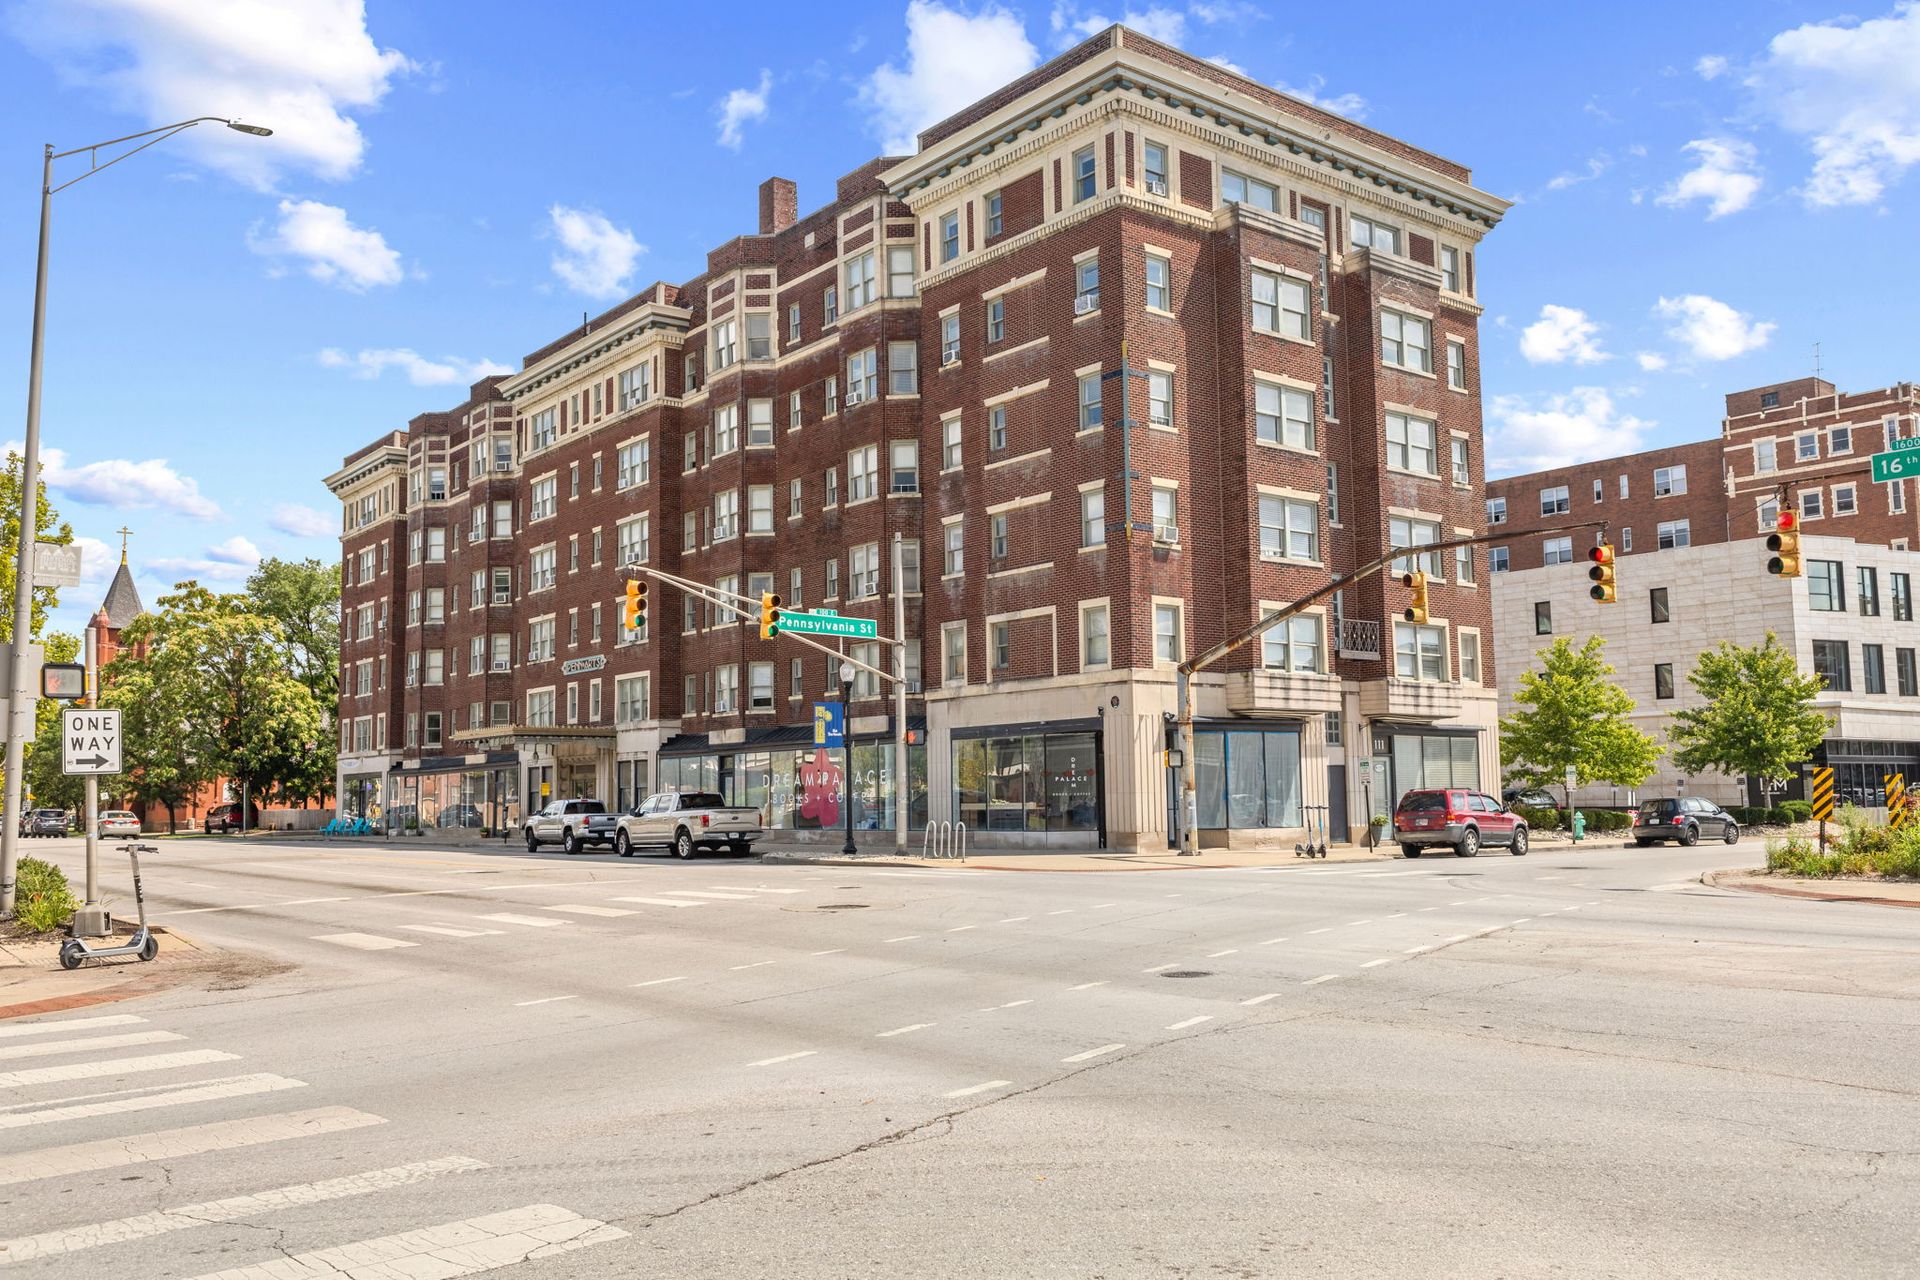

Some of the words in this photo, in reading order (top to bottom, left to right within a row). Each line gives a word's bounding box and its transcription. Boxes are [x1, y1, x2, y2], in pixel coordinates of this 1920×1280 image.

[1896, 438, 1920, 449] 1600
[779, 616, 855, 632] Pennsylvania
[860, 622, 873, 634] St
[72, 716, 113, 731] ONE
[71, 736, 115, 751] WAY
[763, 773, 815, 788] DREAM
[822, 769, 887, 785] PAACE
